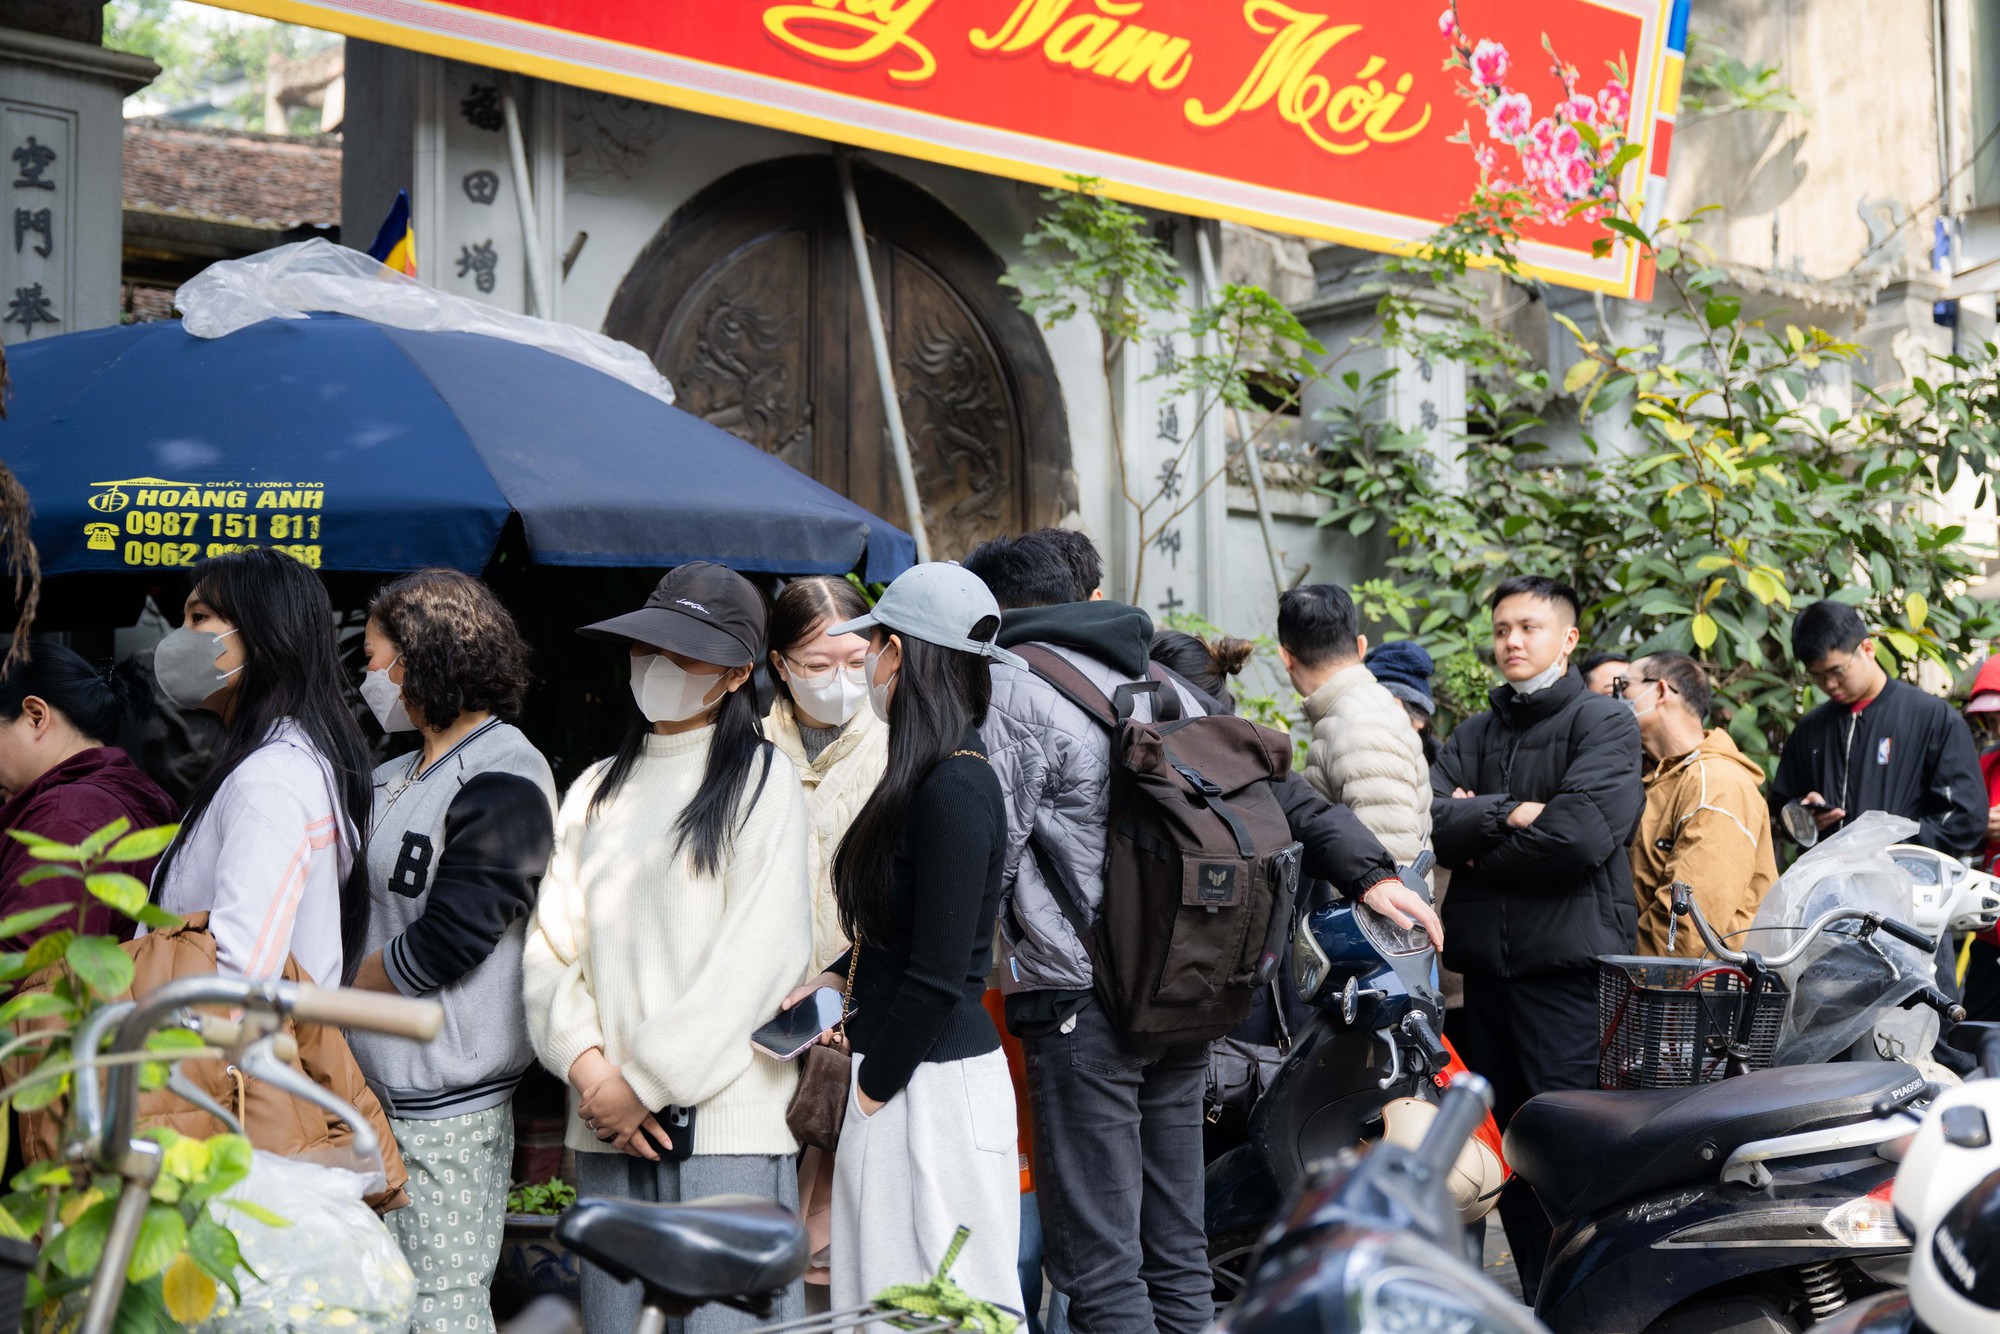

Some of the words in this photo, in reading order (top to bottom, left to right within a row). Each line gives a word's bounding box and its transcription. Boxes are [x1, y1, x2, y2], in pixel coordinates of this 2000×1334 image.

[1184, 0, 1431, 155] Mới
[136, 487, 248, 509] HOÀNG
[255, 490, 325, 509] ANH
[206, 480, 242, 488] CHẤT
[125, 510, 199, 537] 0987
[208, 513, 257, 538] 151
[269, 514, 321, 540] 811
[124, 540, 201, 566] 0962
[272, 544, 322, 570] 68
[388, 830, 434, 898] B
[1891, 1078, 1923, 1100] PIAGGIO
